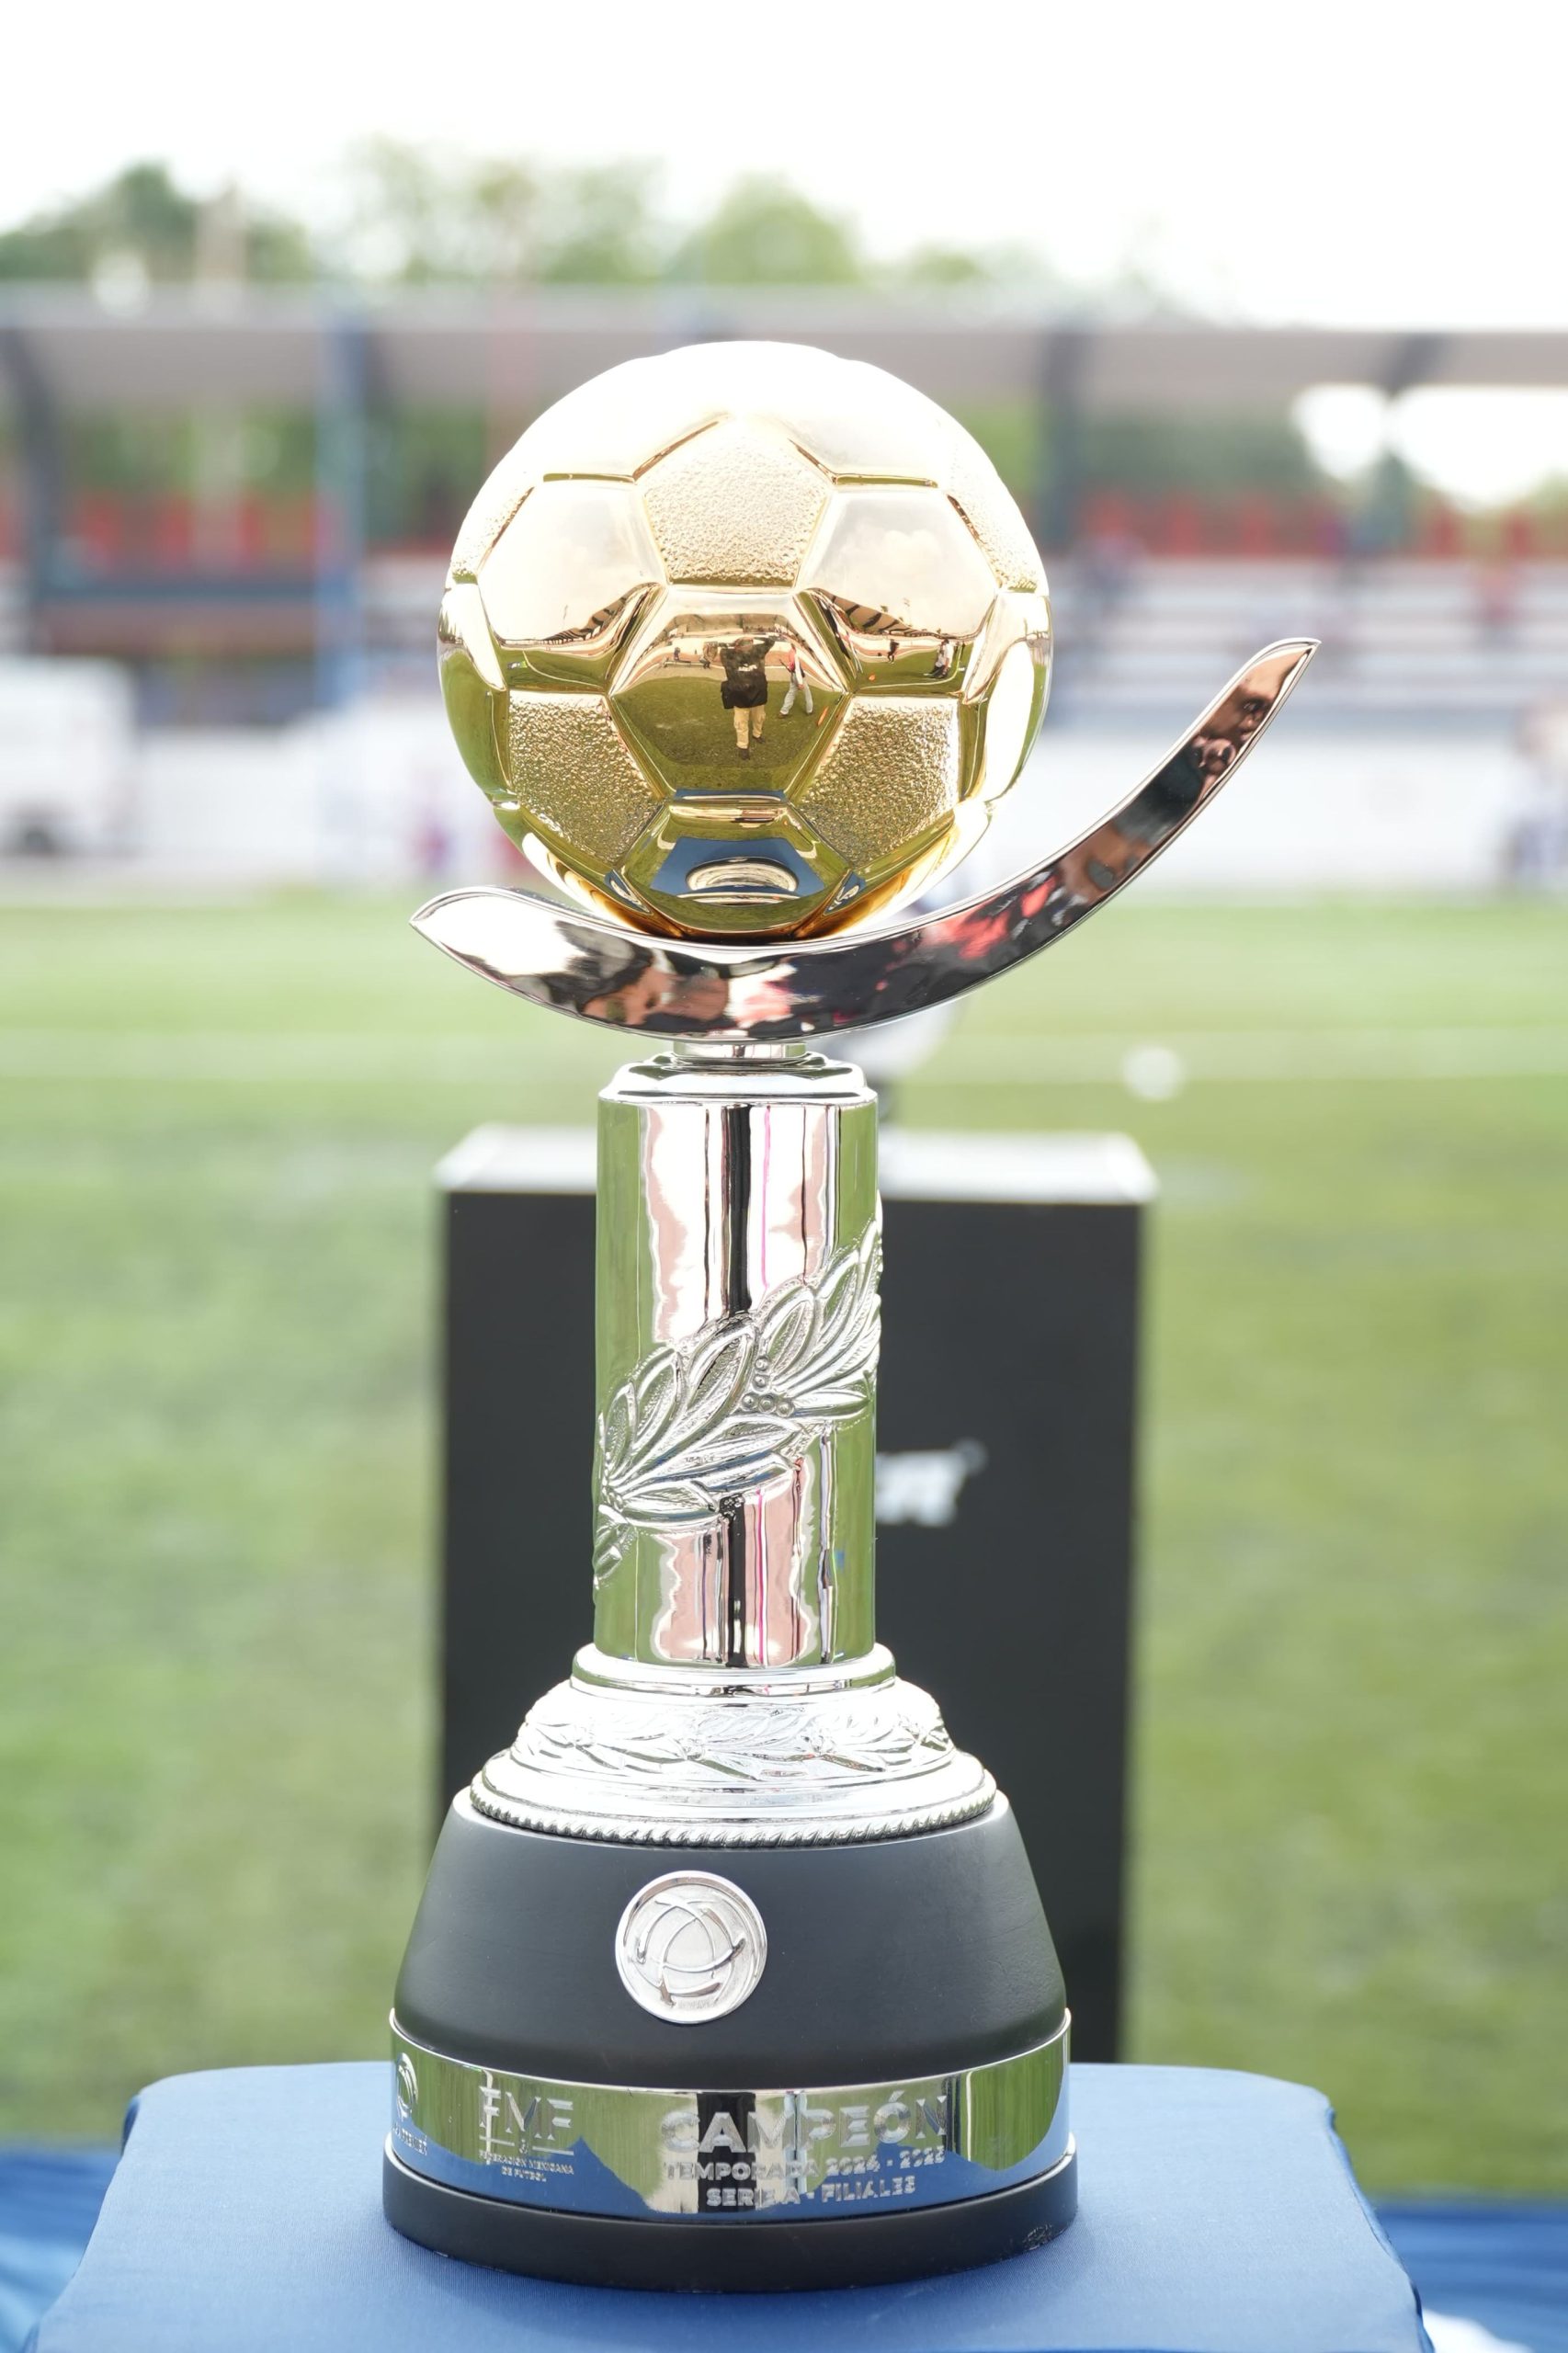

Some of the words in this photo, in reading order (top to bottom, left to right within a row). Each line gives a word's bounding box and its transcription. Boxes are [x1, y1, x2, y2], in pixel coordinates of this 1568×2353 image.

[661, 2090, 948, 2153] CAMPEÓN
[664, 2159, 820, 2181] TEMPORADA
[825, 2154, 881, 2177] 2024
[706, 2186, 776, 2208] SERIE
[782, 2186, 801, 2205] A
[821, 2175, 916, 2203] FILIALES
